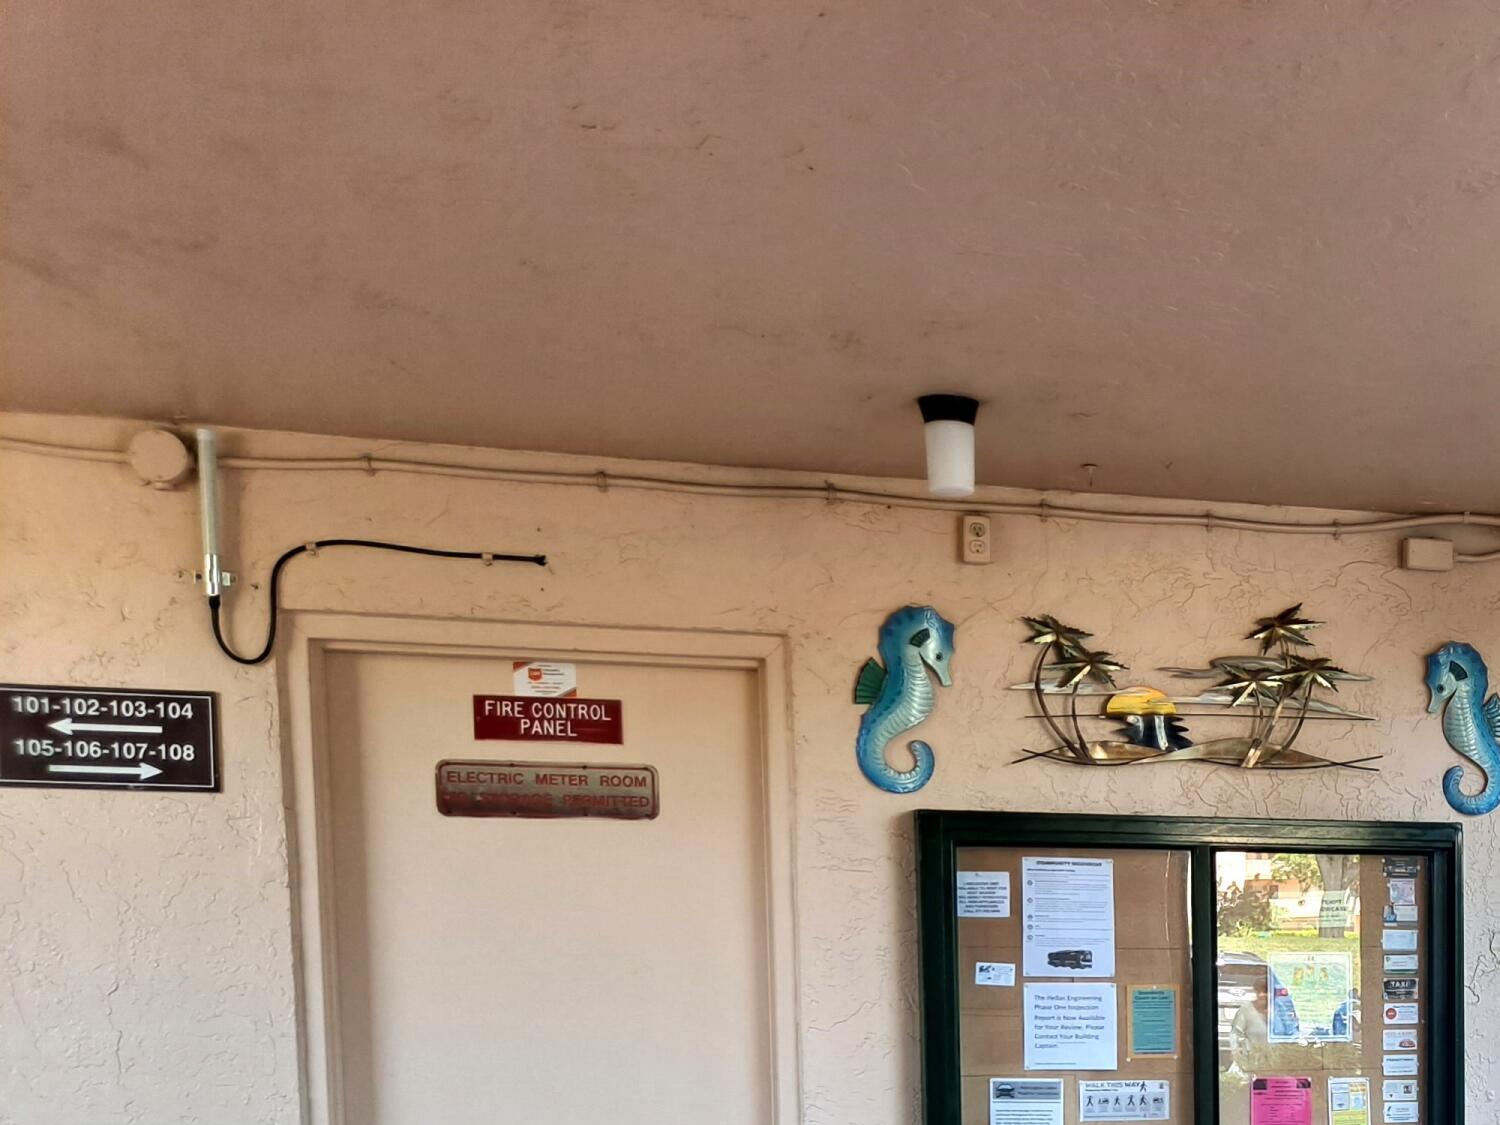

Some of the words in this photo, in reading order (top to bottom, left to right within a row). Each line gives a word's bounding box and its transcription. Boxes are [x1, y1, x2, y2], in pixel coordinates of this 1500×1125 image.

[12, 696, 193, 719] 101-102-103-104
[484, 700, 524, 717] FIRE
[531, 703, 612, 721] CONTROL
[520, 719, 577, 736] PANEL
[14, 739, 195, 761] 105-106-107-108
[446, 771, 524, 785] ELECTRIC
[535, 773, 589, 786] METER
[600, 776, 647, 787] ROOM
[563, 794, 650, 808] PERMITTED
